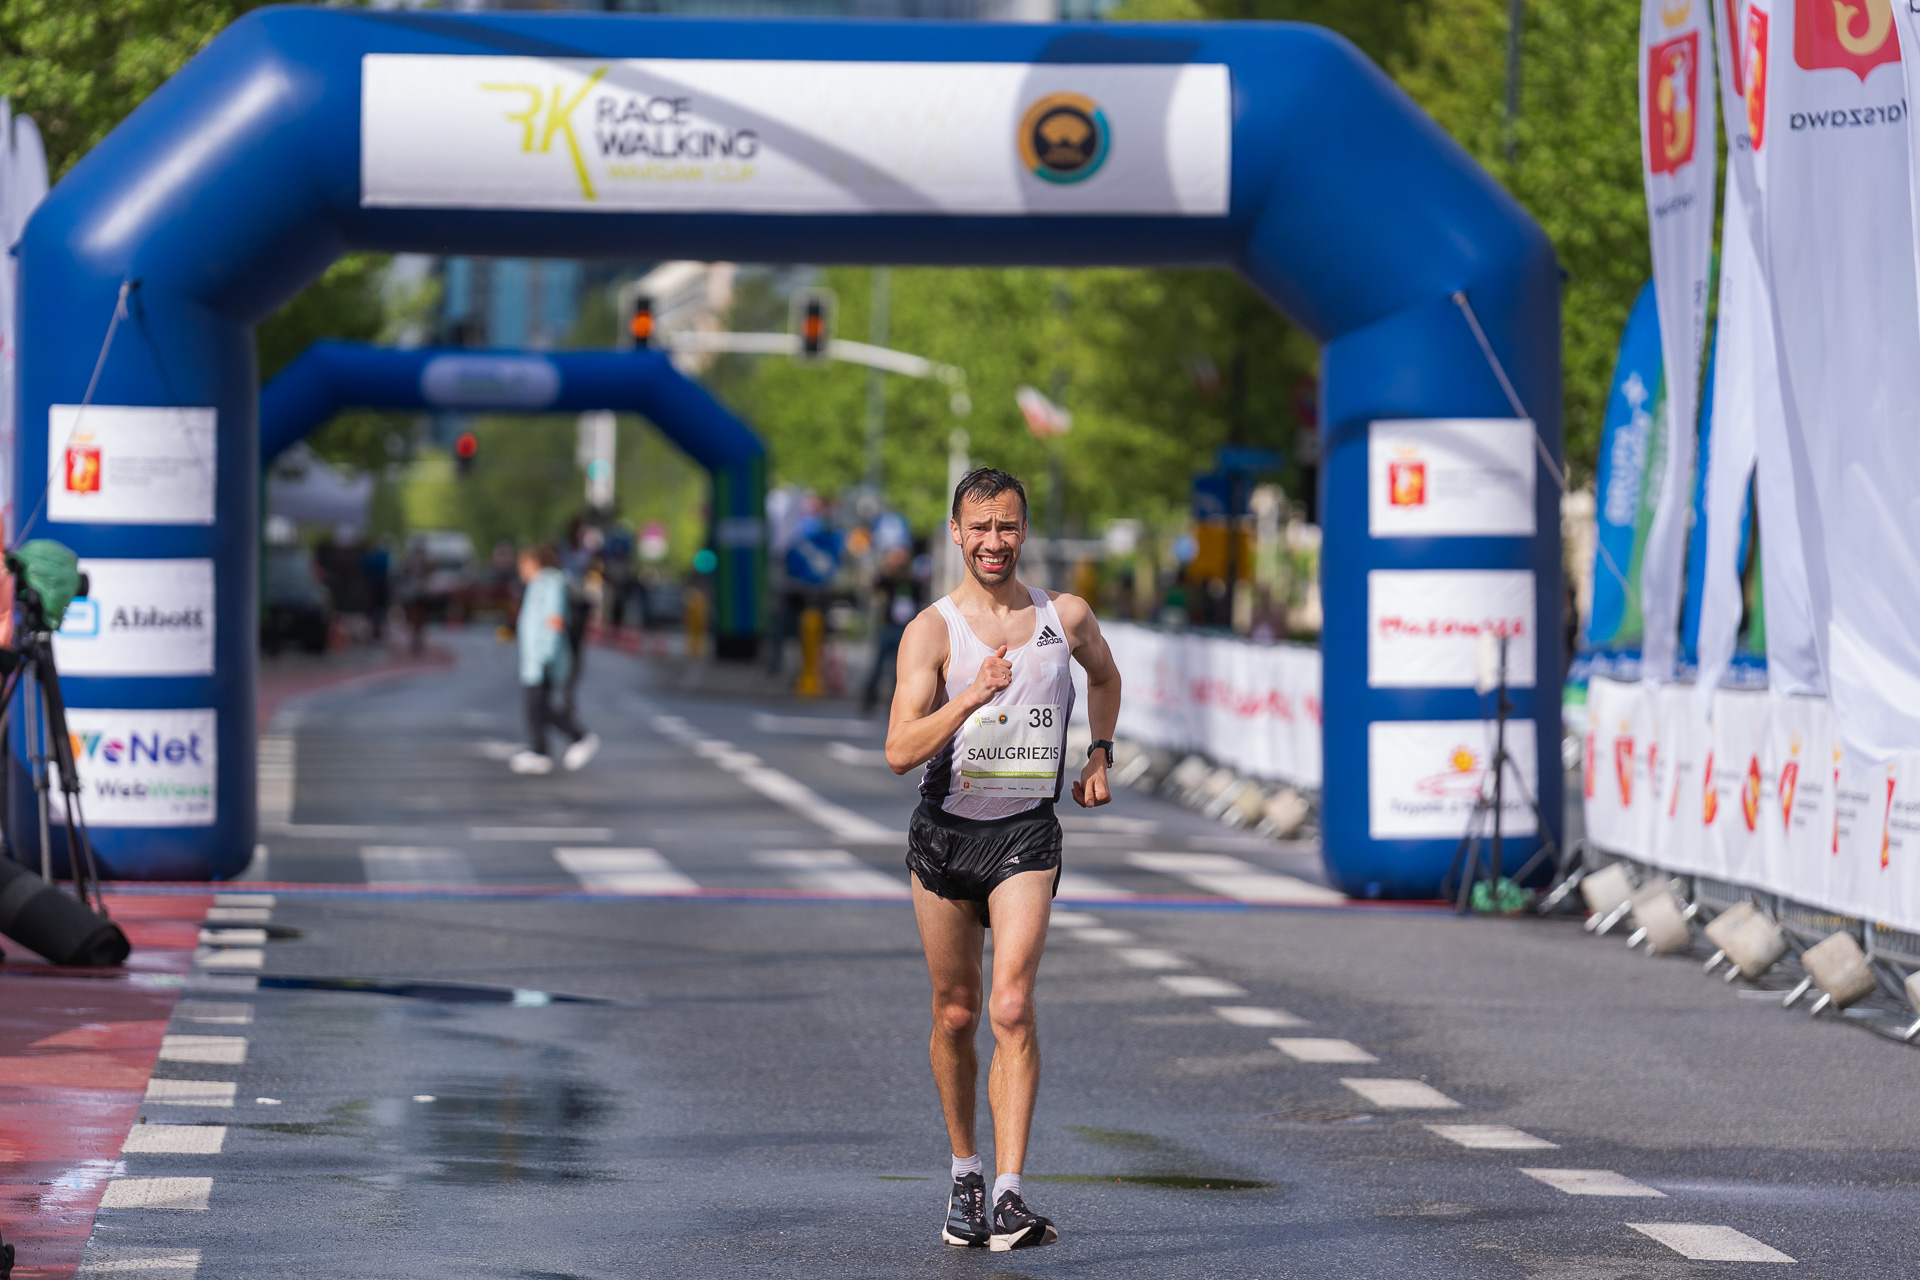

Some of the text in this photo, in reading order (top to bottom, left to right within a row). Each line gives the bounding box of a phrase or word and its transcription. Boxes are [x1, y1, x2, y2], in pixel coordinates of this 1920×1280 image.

[596, 96, 690, 124] RACE
[596, 130, 758, 158] WALKING
[111, 605, 203, 628] Abbott
[1037, 637, 1063, 647] adidas
[1029, 708, 1053, 728] 38
[967, 747, 1059, 760] SAULGRIEZIS
